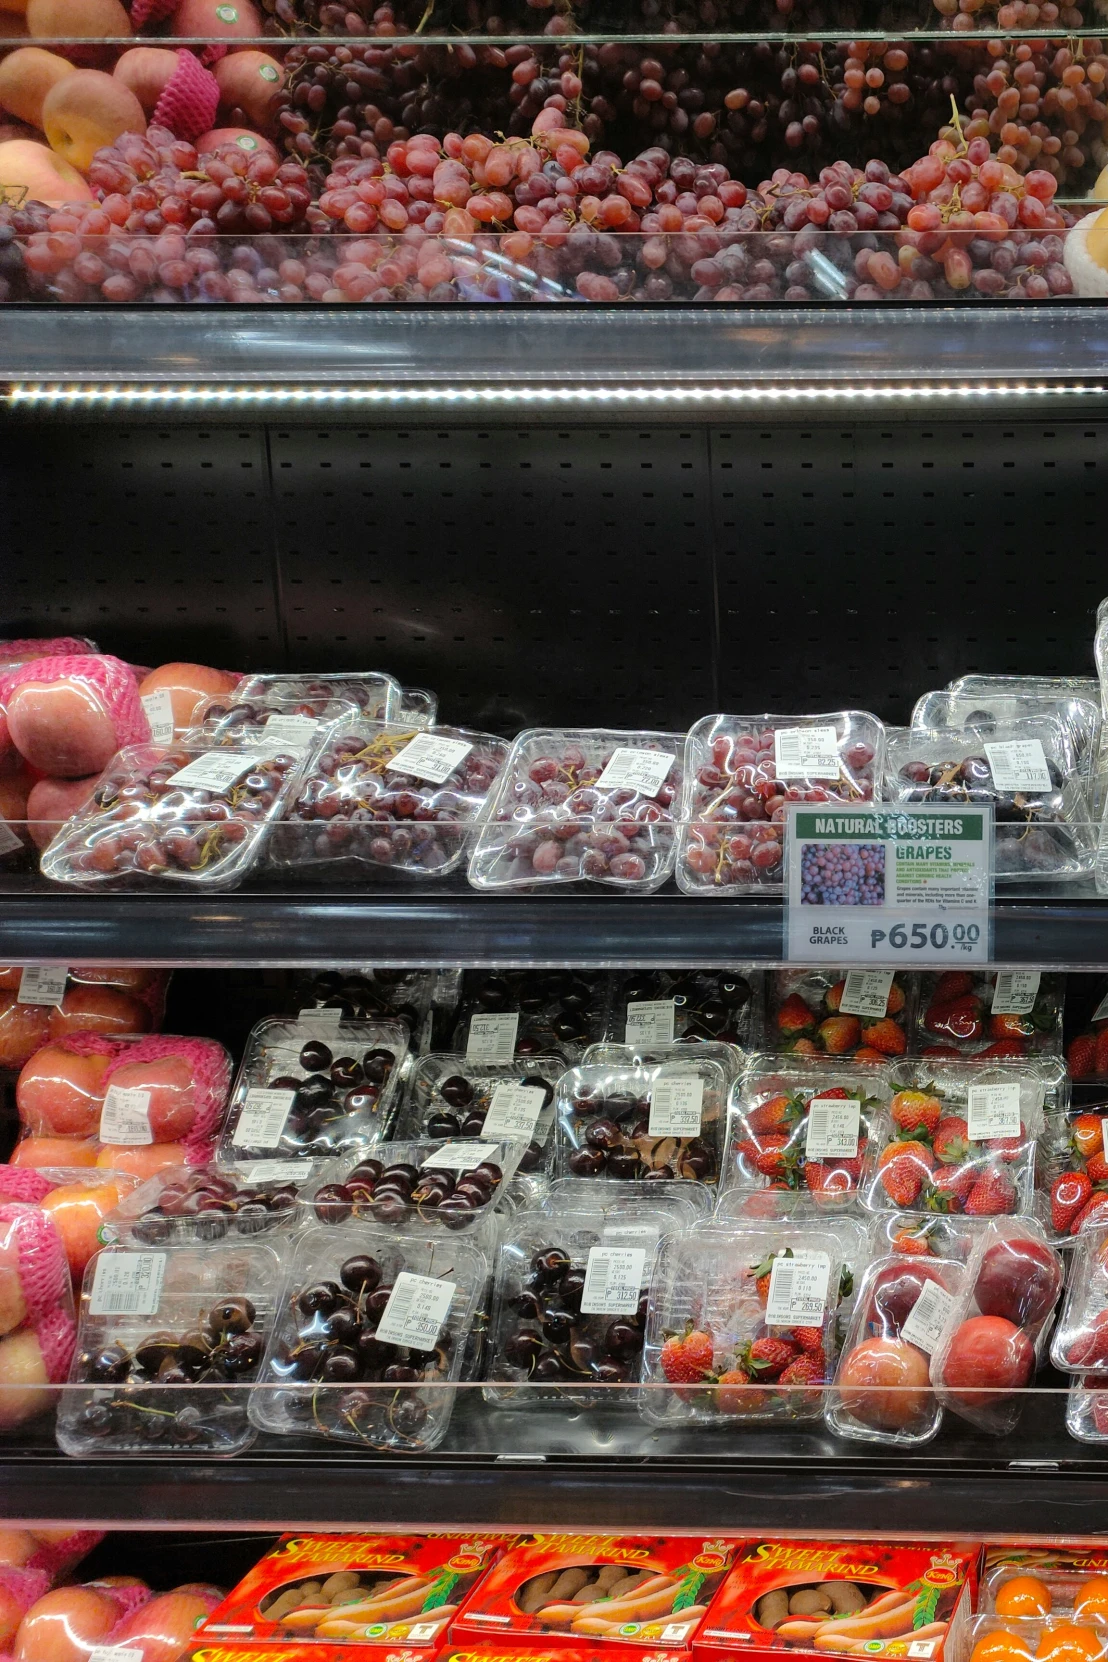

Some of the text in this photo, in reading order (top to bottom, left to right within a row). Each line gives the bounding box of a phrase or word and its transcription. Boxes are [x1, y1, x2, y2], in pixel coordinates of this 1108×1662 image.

[815, 818, 963, 835] NATURAL BOOSTERS
[896, 846, 952, 860] GRAPES
[813, 926, 845, 935] BLACK
[809, 936, 848, 945] GRAPES
[960, 943, 972, 952] /kg
[419, 1279, 442, 1288] cherries
[617, 1292, 637, 1300] 312.50
[802, 1303, 822, 1311] 269.50
[416, 1322, 438, 1335] 350.00
[405, 1334, 433, 1344] SUPERMARKET
[516, 1534, 622, 1548] SWEET
[268, 1538, 379, 1560] SWEET
[536, 1543, 649, 1560] TAMARIND
[742, 1544, 848, 1564] SWEET
[286, 1552, 405, 1564] TAMARIND
[763, 1558, 879, 1575] TAMARIND
